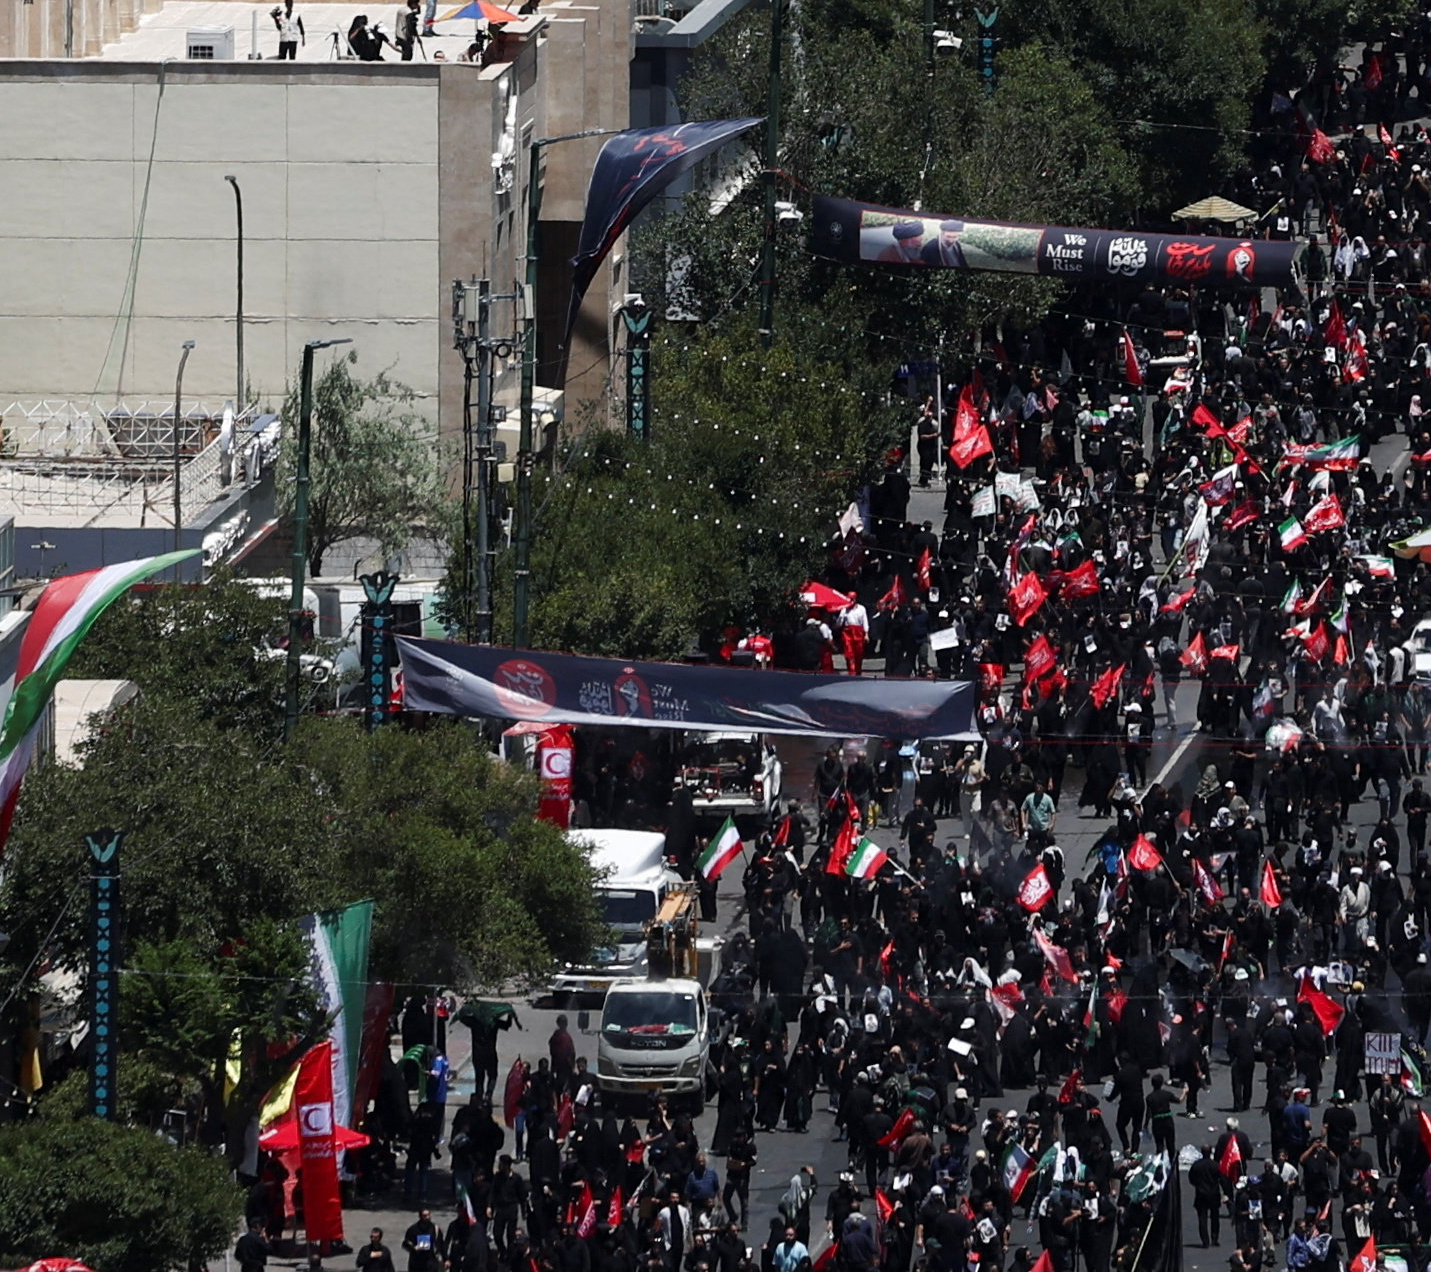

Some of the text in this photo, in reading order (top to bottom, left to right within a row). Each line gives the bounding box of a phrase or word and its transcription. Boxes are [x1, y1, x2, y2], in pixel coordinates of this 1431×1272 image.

[1064, 234, 1087, 246] We
[1046, 244, 1083, 259] Must
[1052, 258, 1083, 272] Rise
